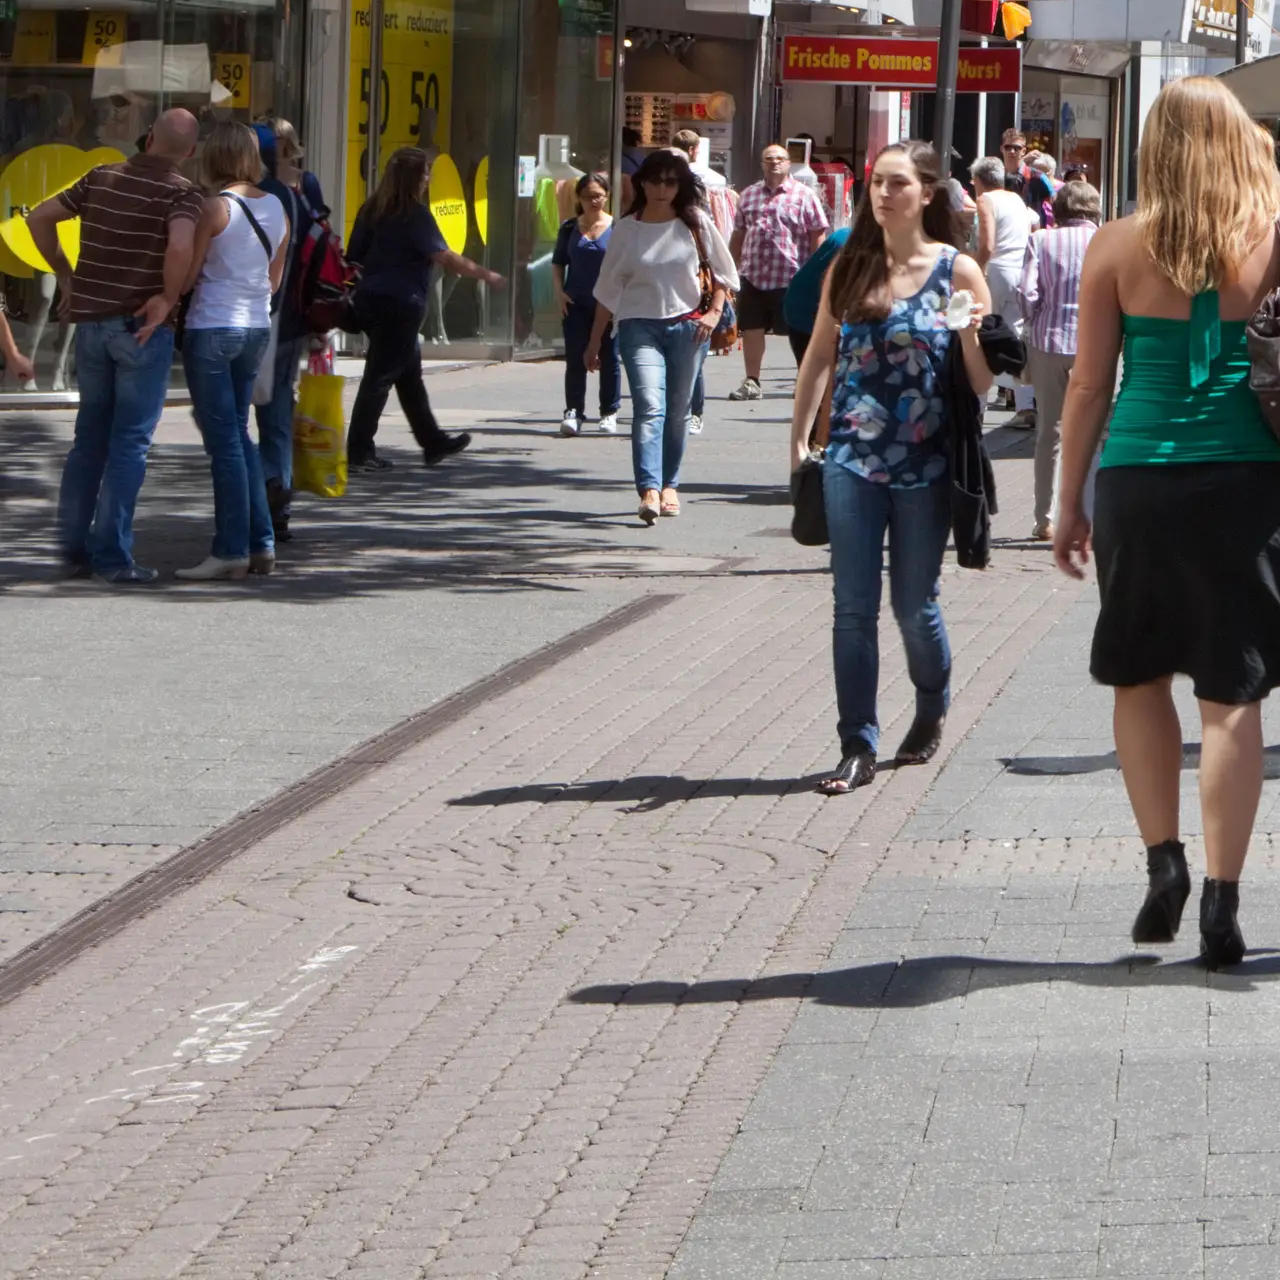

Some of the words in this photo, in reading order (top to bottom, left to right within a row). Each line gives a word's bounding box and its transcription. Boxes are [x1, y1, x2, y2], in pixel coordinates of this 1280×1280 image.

[94, 20, 117, 37] 50
[405, 9, 448, 35] reduziert
[788, 46, 850, 69] Frische
[856, 48, 932, 71] Pommes
[221, 63, 243, 81] 50
[434, 202, 465, 217] reduziert
